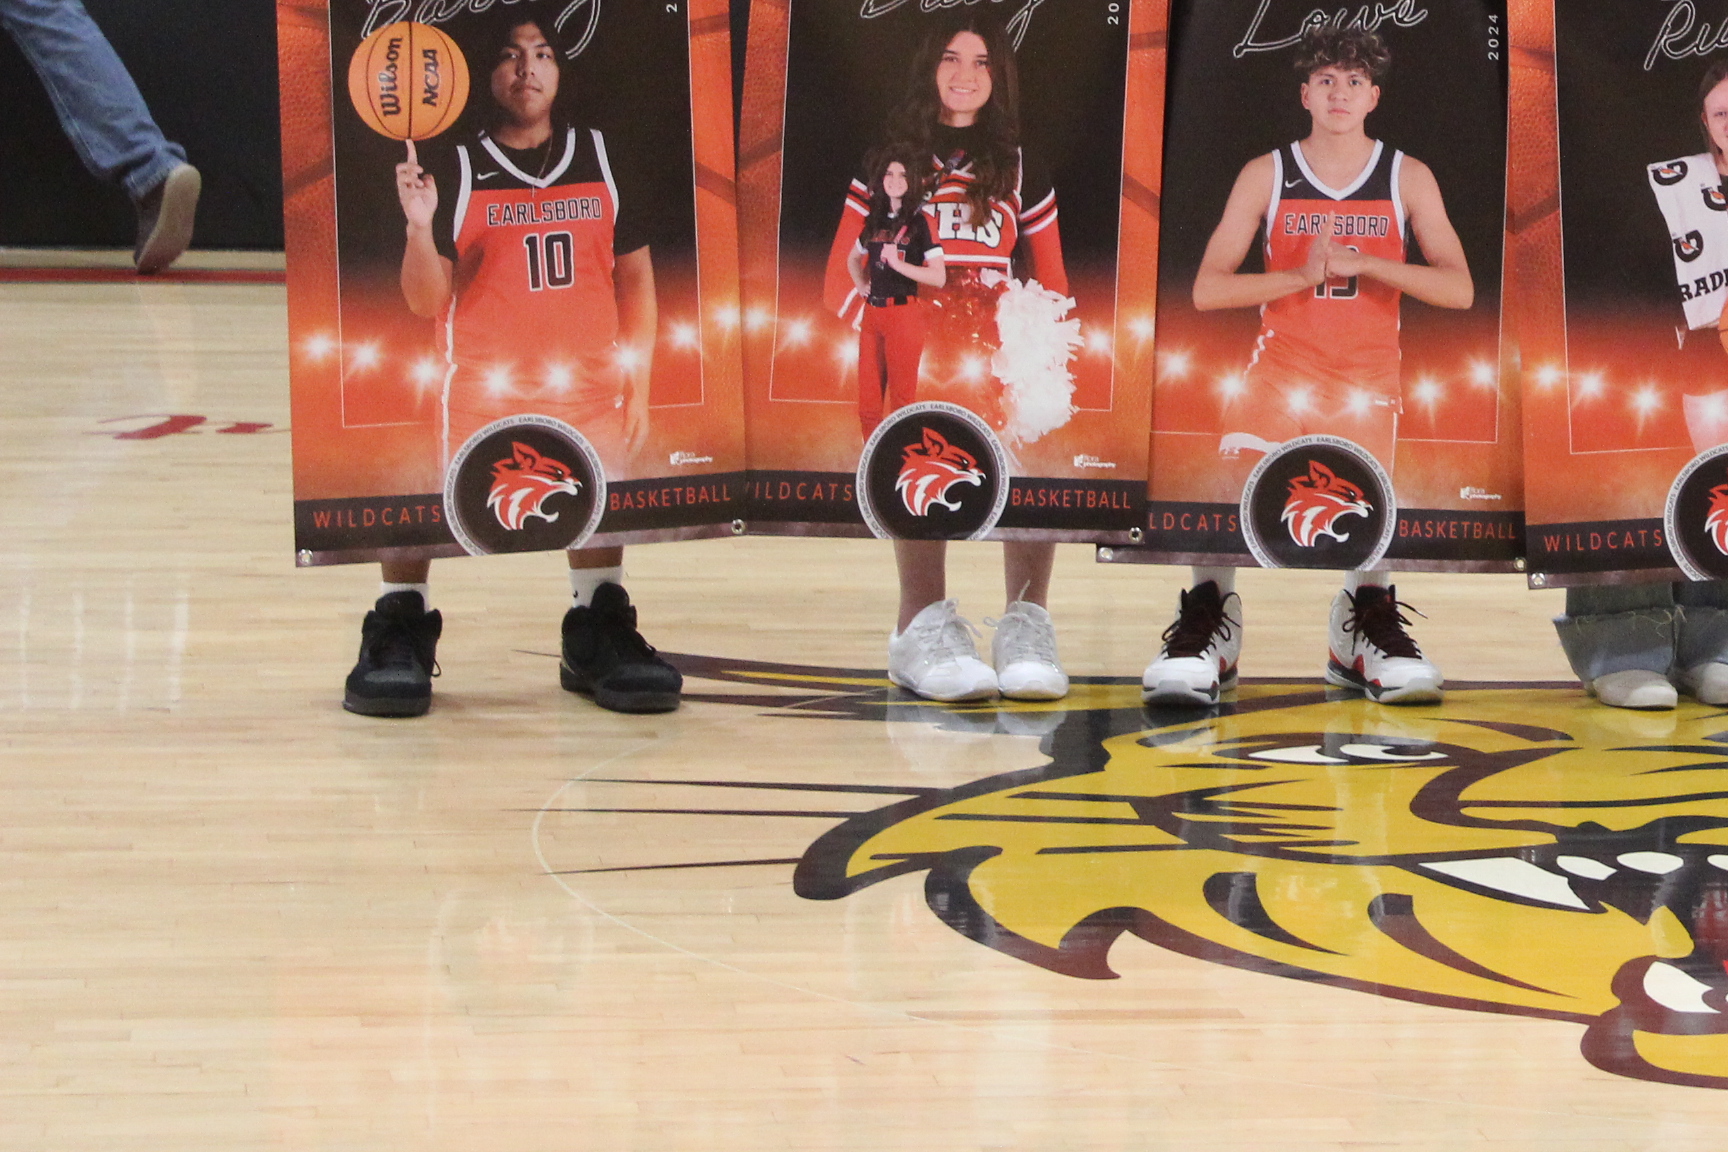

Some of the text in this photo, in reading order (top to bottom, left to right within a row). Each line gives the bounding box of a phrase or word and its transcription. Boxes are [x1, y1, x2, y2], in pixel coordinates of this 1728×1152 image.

[1488, 13, 1499, 61] 2024
[379, 37, 402, 117] Wilson
[422, 48, 438, 107] NCAA
[487, 197, 602, 227] EARLSBORO
[922, 202, 1004, 248] HS
[1284, 213, 1390, 238] EARSBORO
[523, 230, 575, 292] 10
[609, 482, 731, 512] BASKETBALL
[744, 481, 853, 502] ILDCATS
[1012, 489, 1131, 510] BASKETBALL
[313, 505, 441, 530] WILDCATS
[1400, 519, 1517, 541] BASKETBALL
[1544, 529, 1662, 552] WILDCATS
